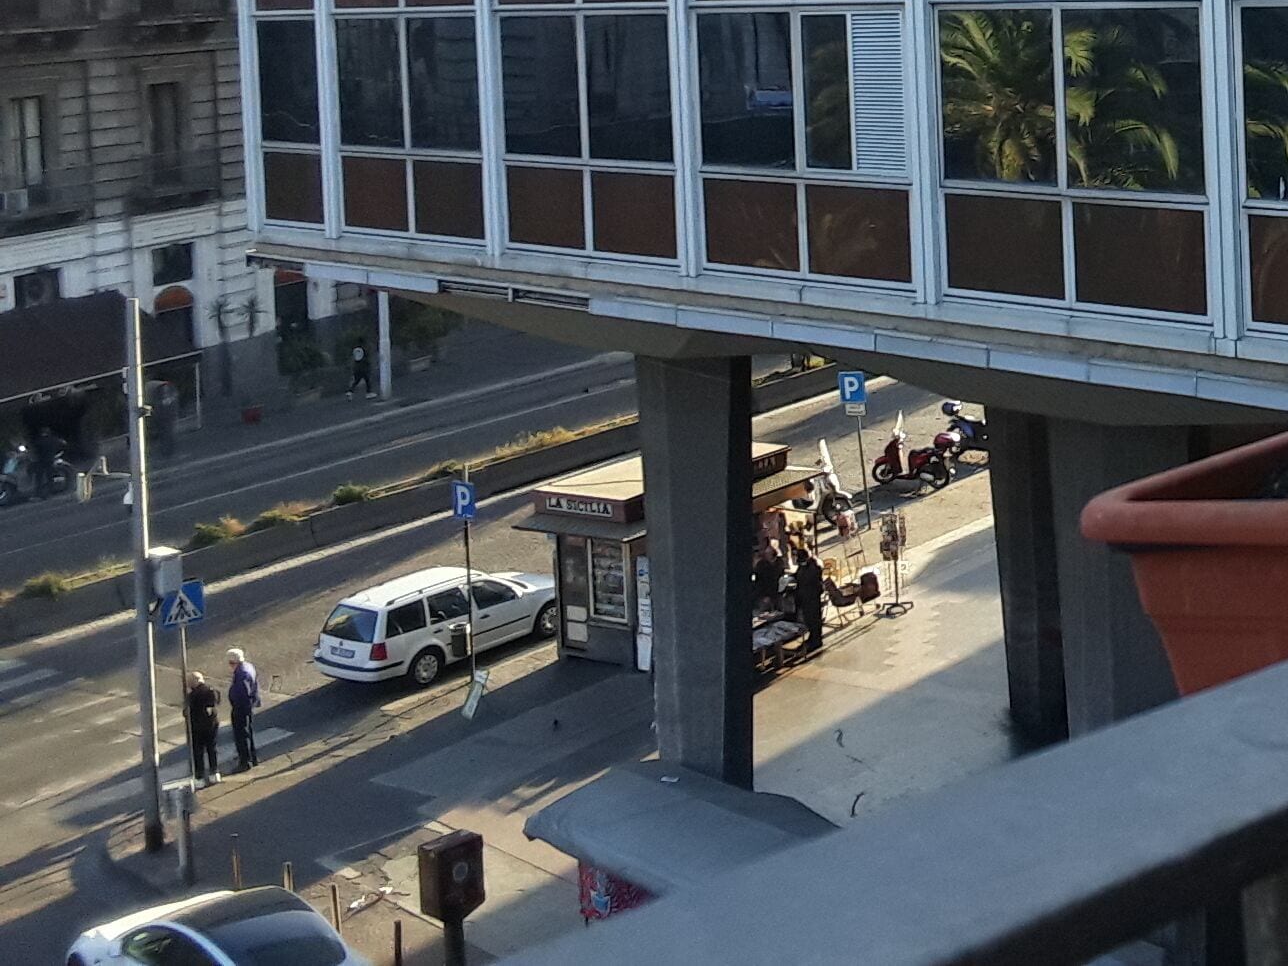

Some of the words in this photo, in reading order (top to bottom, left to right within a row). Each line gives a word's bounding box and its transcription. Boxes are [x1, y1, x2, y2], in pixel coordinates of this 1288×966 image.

[844, 376, 860, 400] P
[455, 484, 470, 515] P
[548, 497, 563, 508] LA
[566, 499, 611, 515] SICILIA
